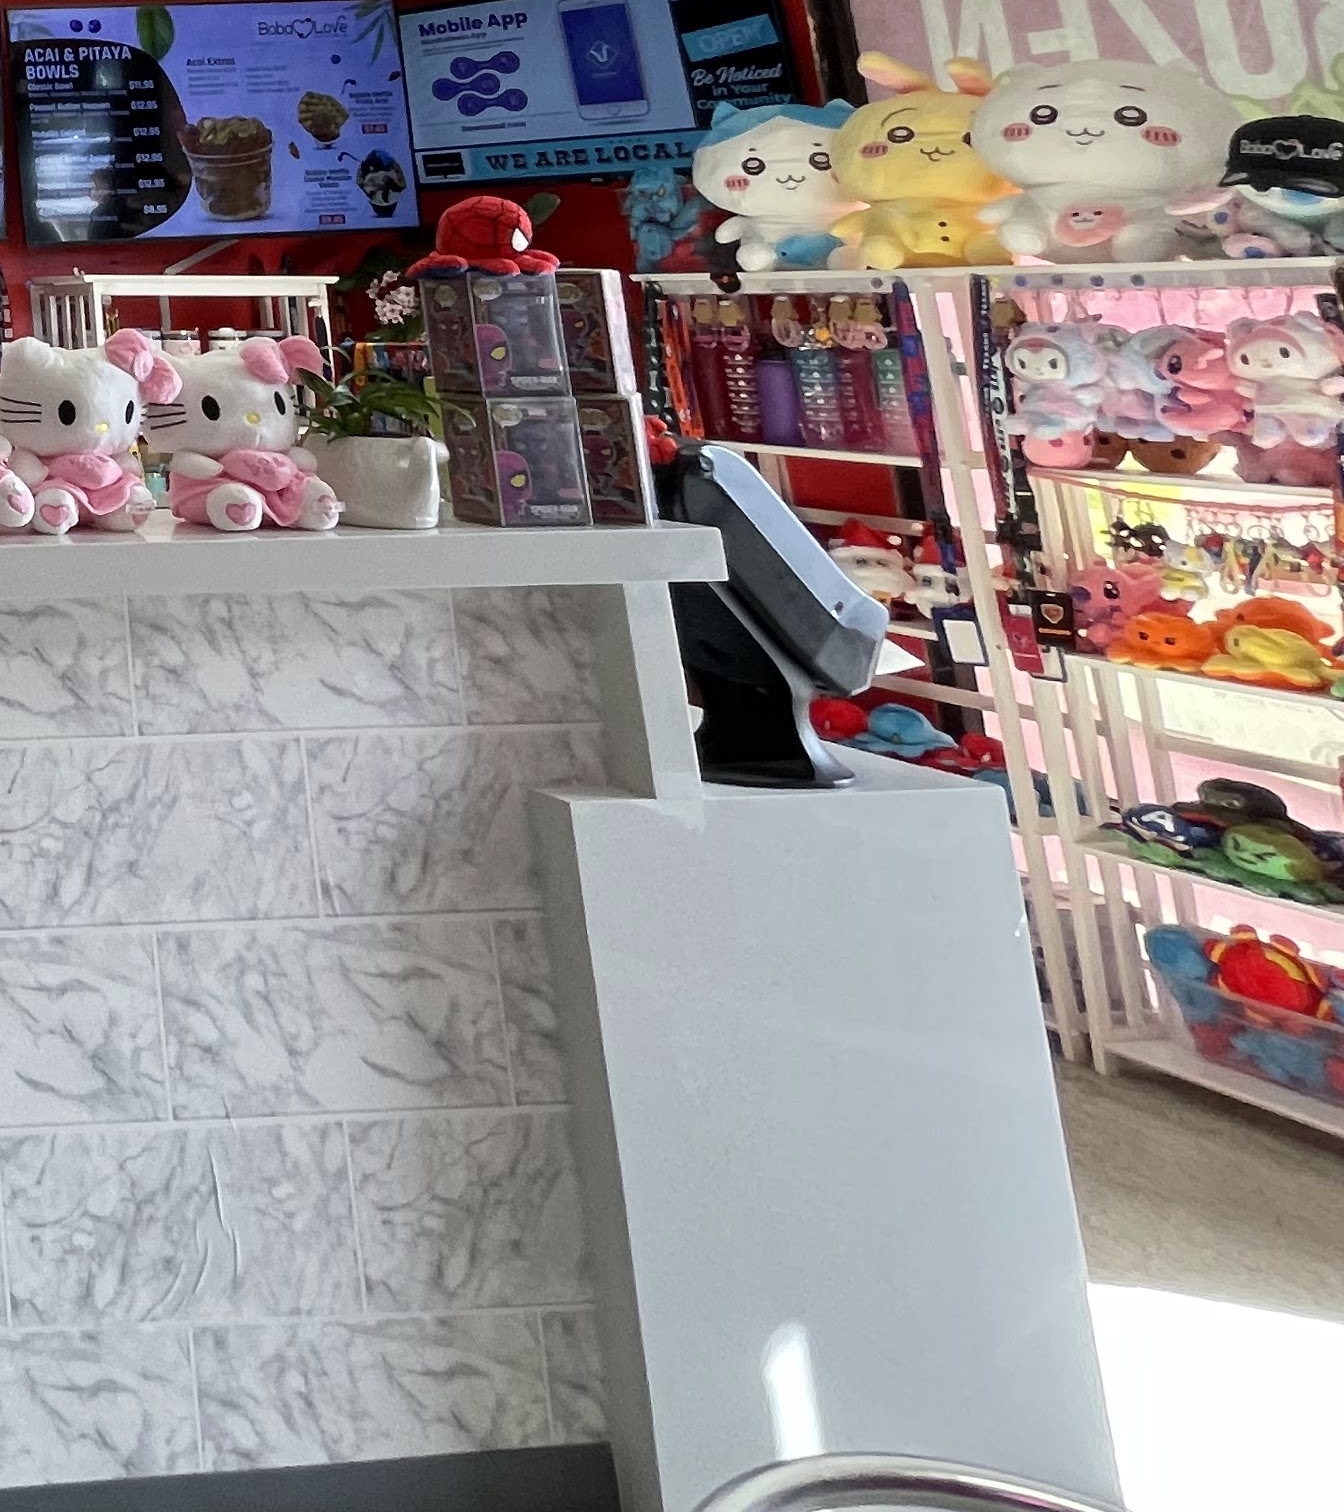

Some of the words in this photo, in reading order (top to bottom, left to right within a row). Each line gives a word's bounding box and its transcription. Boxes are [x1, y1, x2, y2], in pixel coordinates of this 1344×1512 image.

[258, 21, 293, 36] Boba
[314, 15, 348, 34] Love
[418, 16, 483, 38] Mobile
[487, 12, 528, 31] App
[24, 47, 60, 63] ACAI
[64, 47, 75, 62] &
[79, 46, 132, 62] PITAYA
[26, 64, 80, 80] BOWLS
[691, 68, 714, 87] Be
[716, 63, 783, 83] Noticed
[485, 153, 526, 172] WE
[534, 148, 590, 170] ARE
[594, 141, 695, 165] LOCAL
